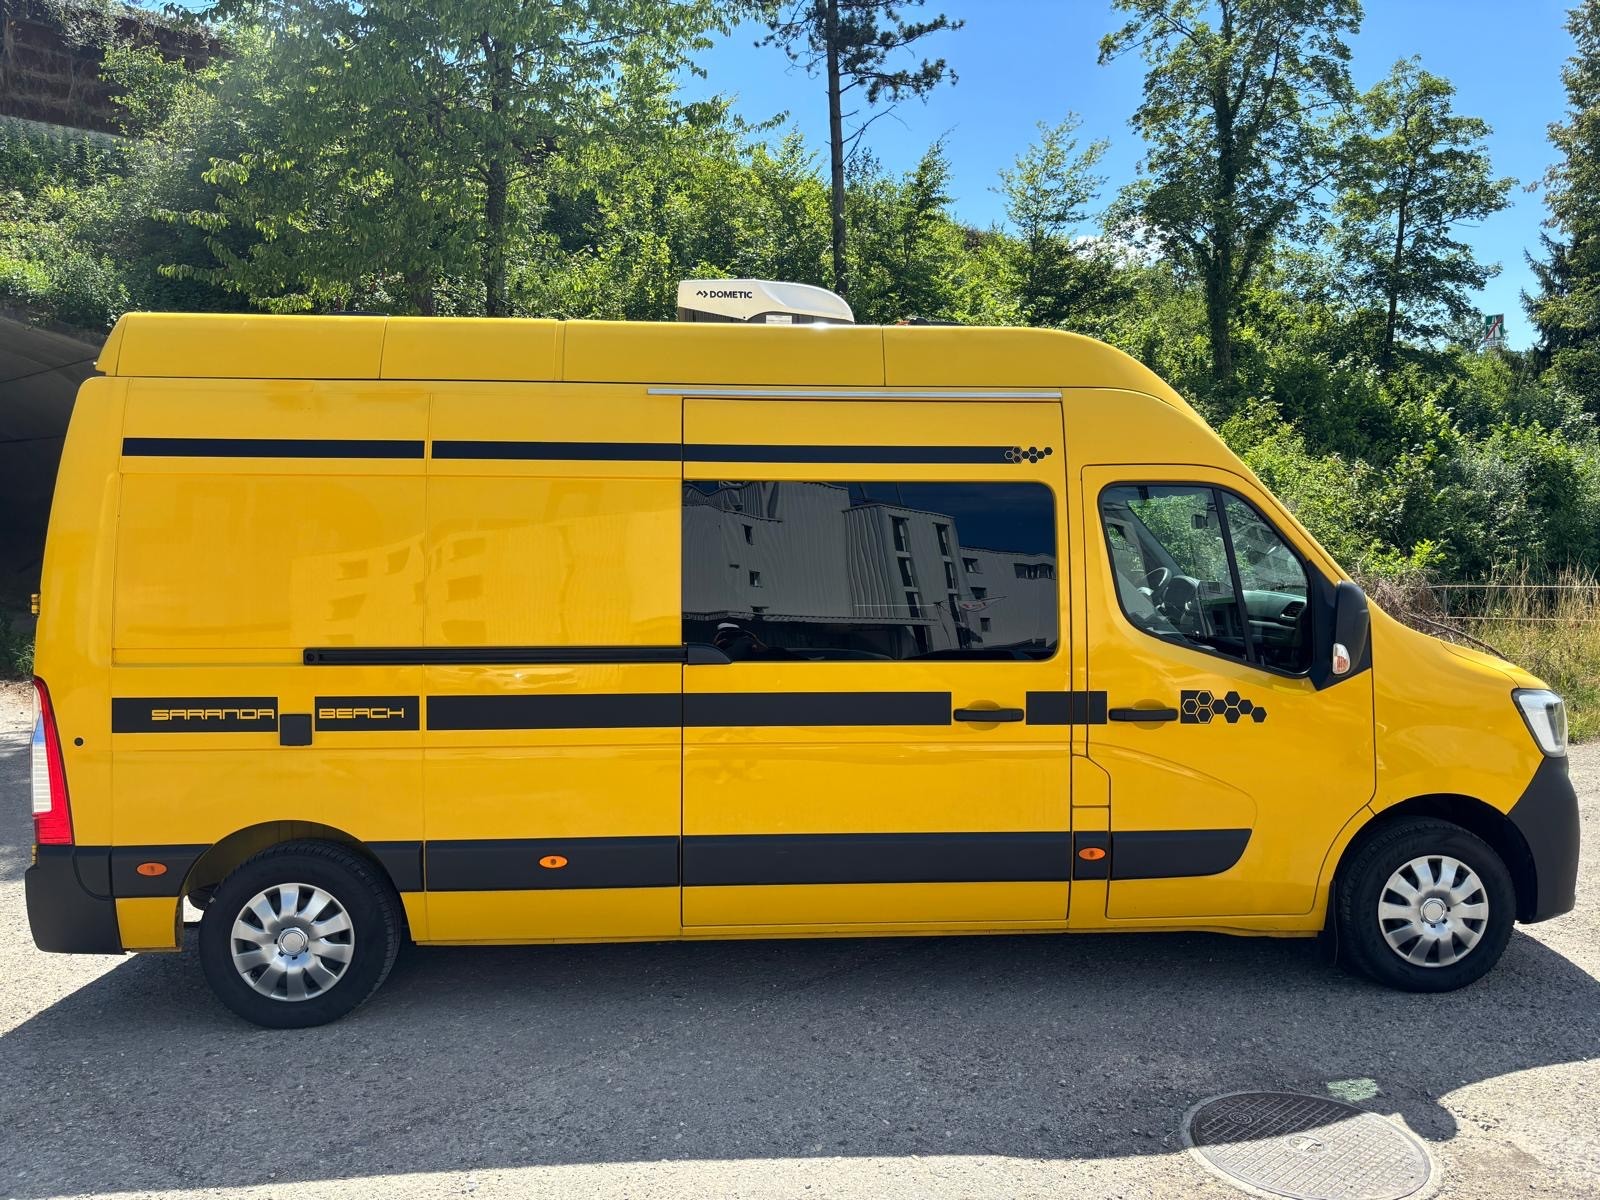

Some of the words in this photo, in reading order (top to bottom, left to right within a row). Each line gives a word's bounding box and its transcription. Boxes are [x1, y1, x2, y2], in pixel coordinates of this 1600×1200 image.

[709, 290, 753, 299] DOMETIC
[151, 708, 275, 721] SARANDA
[318, 707, 405, 719] BEACH
